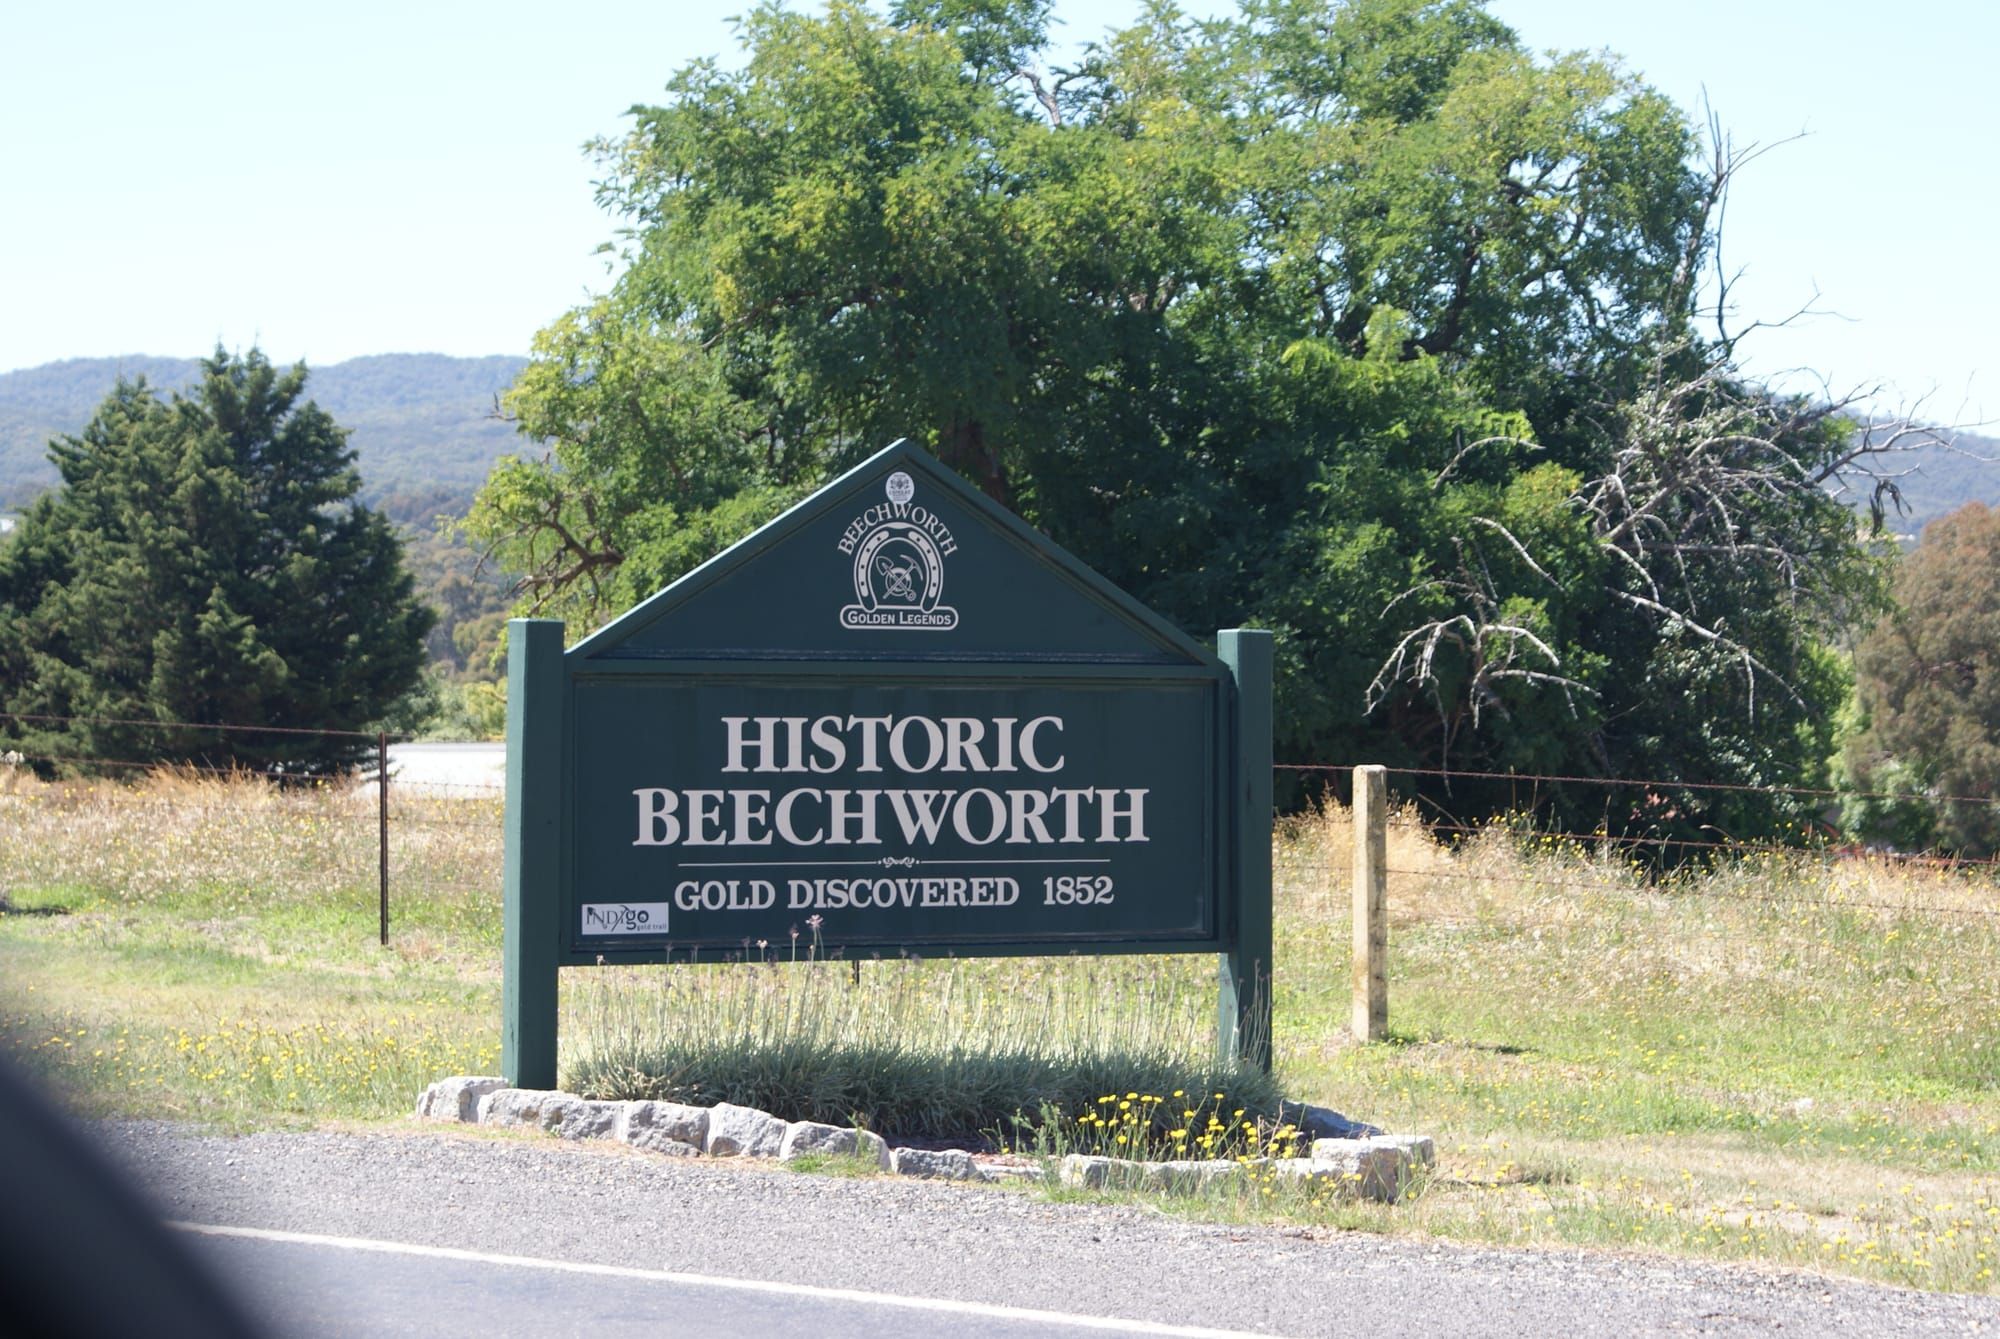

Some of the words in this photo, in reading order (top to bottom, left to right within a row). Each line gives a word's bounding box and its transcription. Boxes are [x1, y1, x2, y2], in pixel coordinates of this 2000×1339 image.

[838, 502, 958, 556] BEECHWORTH
[847, 610, 895, 625] GOLDEN
[900, 611, 952, 625] LEGENDS
[720, 715, 1065, 774] HISTORIC
[633, 786, 1150, 846] BEECHWORTH
[674, 880, 776, 911] GOLD
[788, 878, 1020, 909] DISCOVERED
[1043, 876, 1115, 905] 1852
